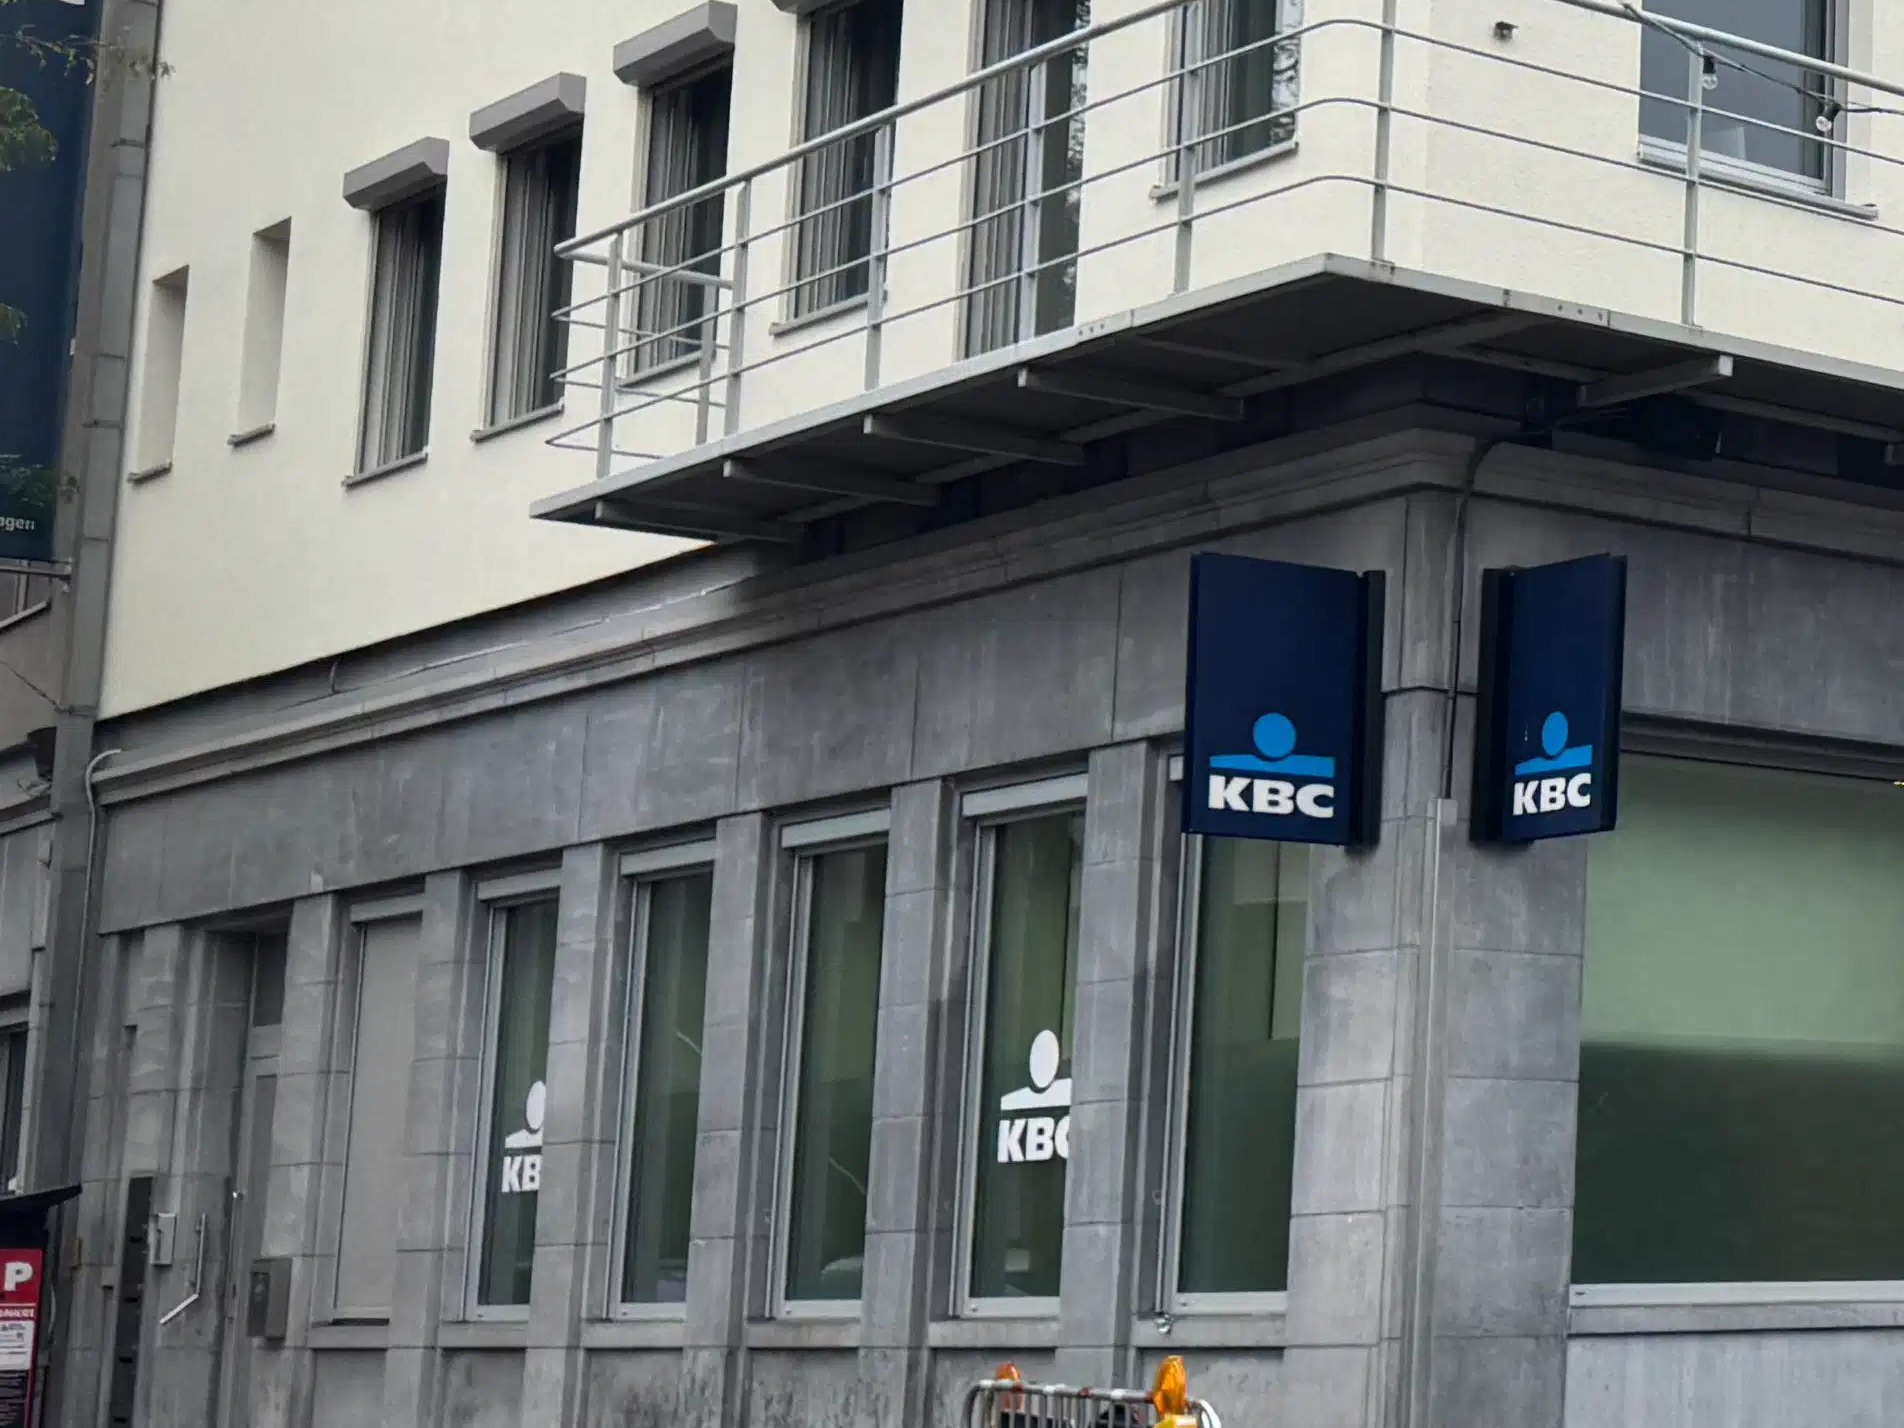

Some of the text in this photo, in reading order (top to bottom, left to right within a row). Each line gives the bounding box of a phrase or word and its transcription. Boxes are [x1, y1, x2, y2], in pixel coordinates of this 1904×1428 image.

[1208, 774, 1335, 819] KBC
[1513, 773, 1591, 817] KBC
[502, 1155, 541, 1193] KB
